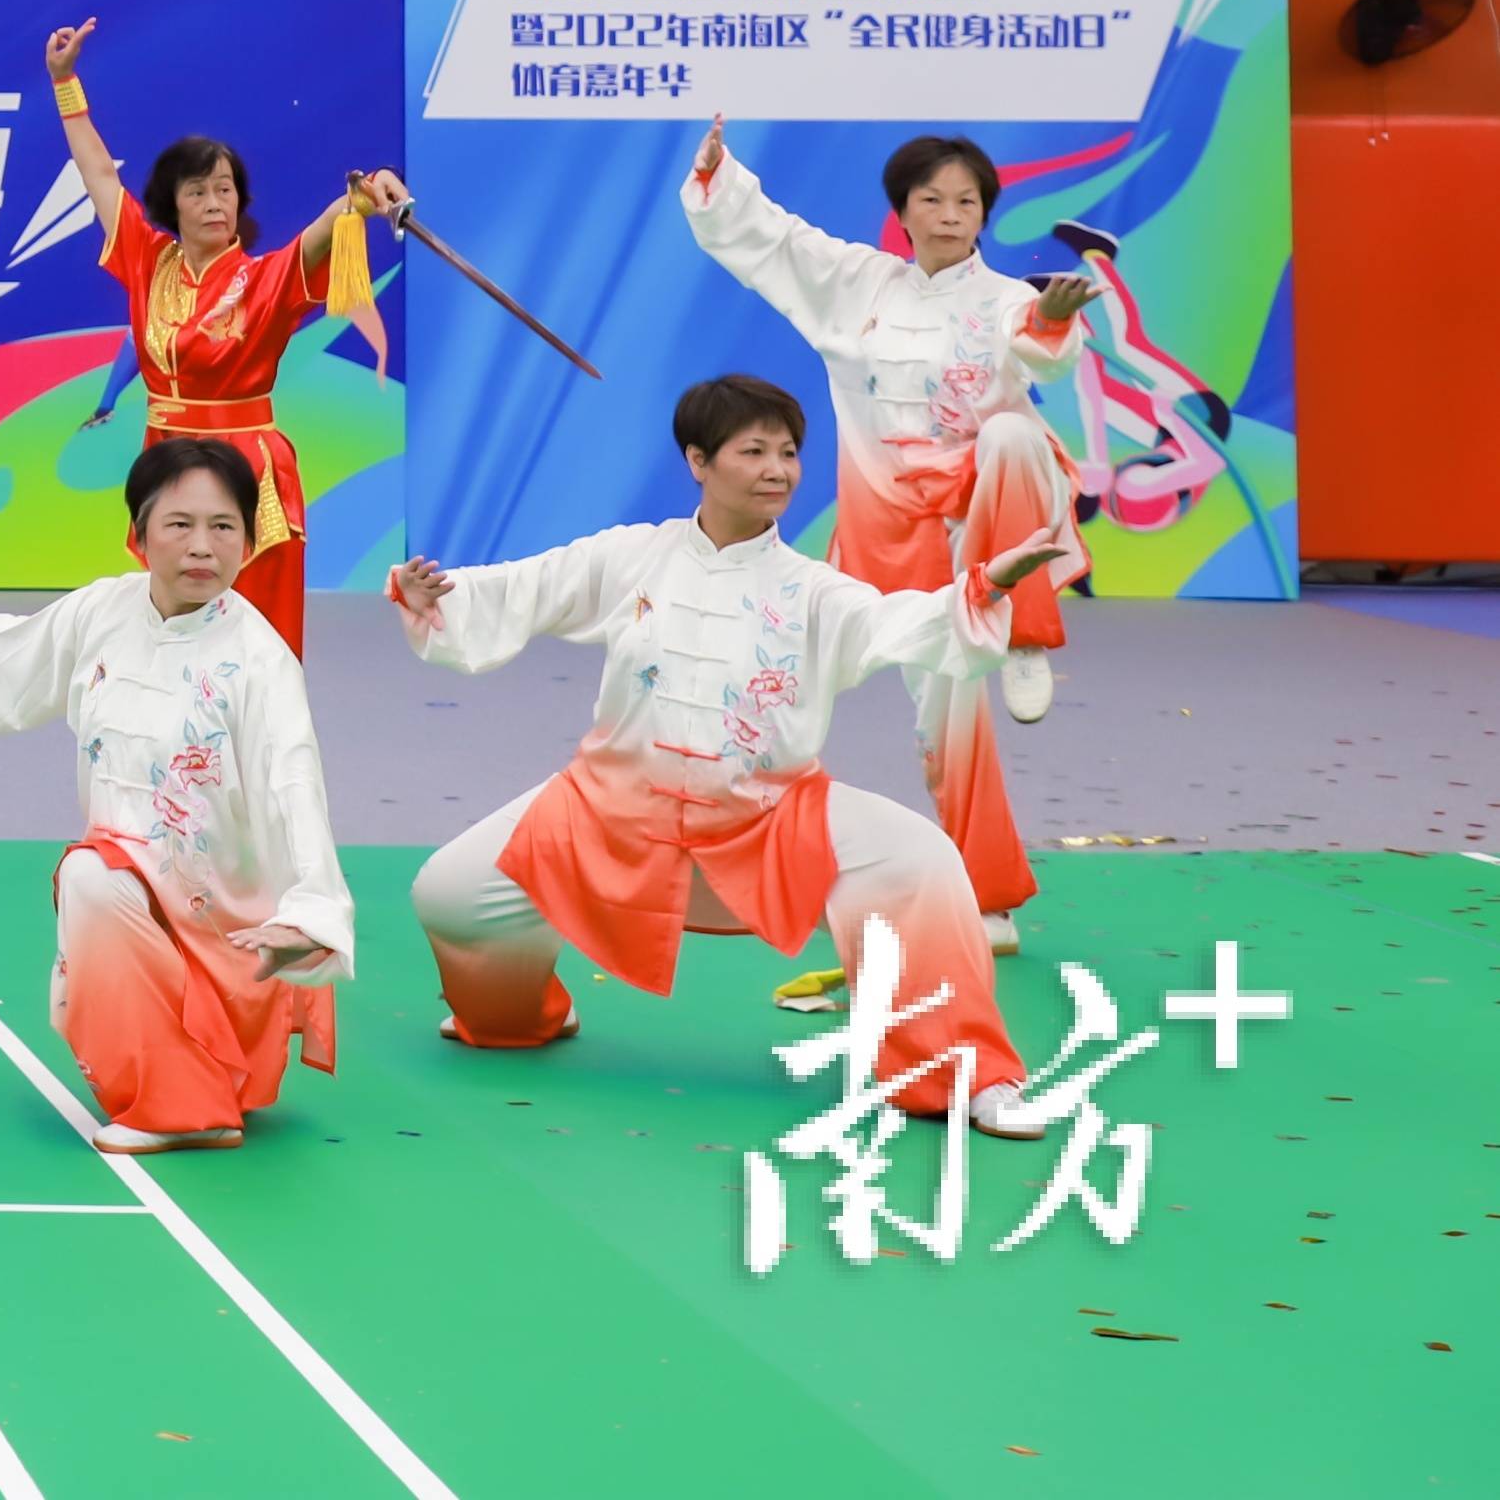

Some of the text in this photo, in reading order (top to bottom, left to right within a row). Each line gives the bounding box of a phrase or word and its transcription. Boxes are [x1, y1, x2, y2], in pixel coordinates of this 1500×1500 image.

[511, 62, 693, 98] 体育嘉年华
